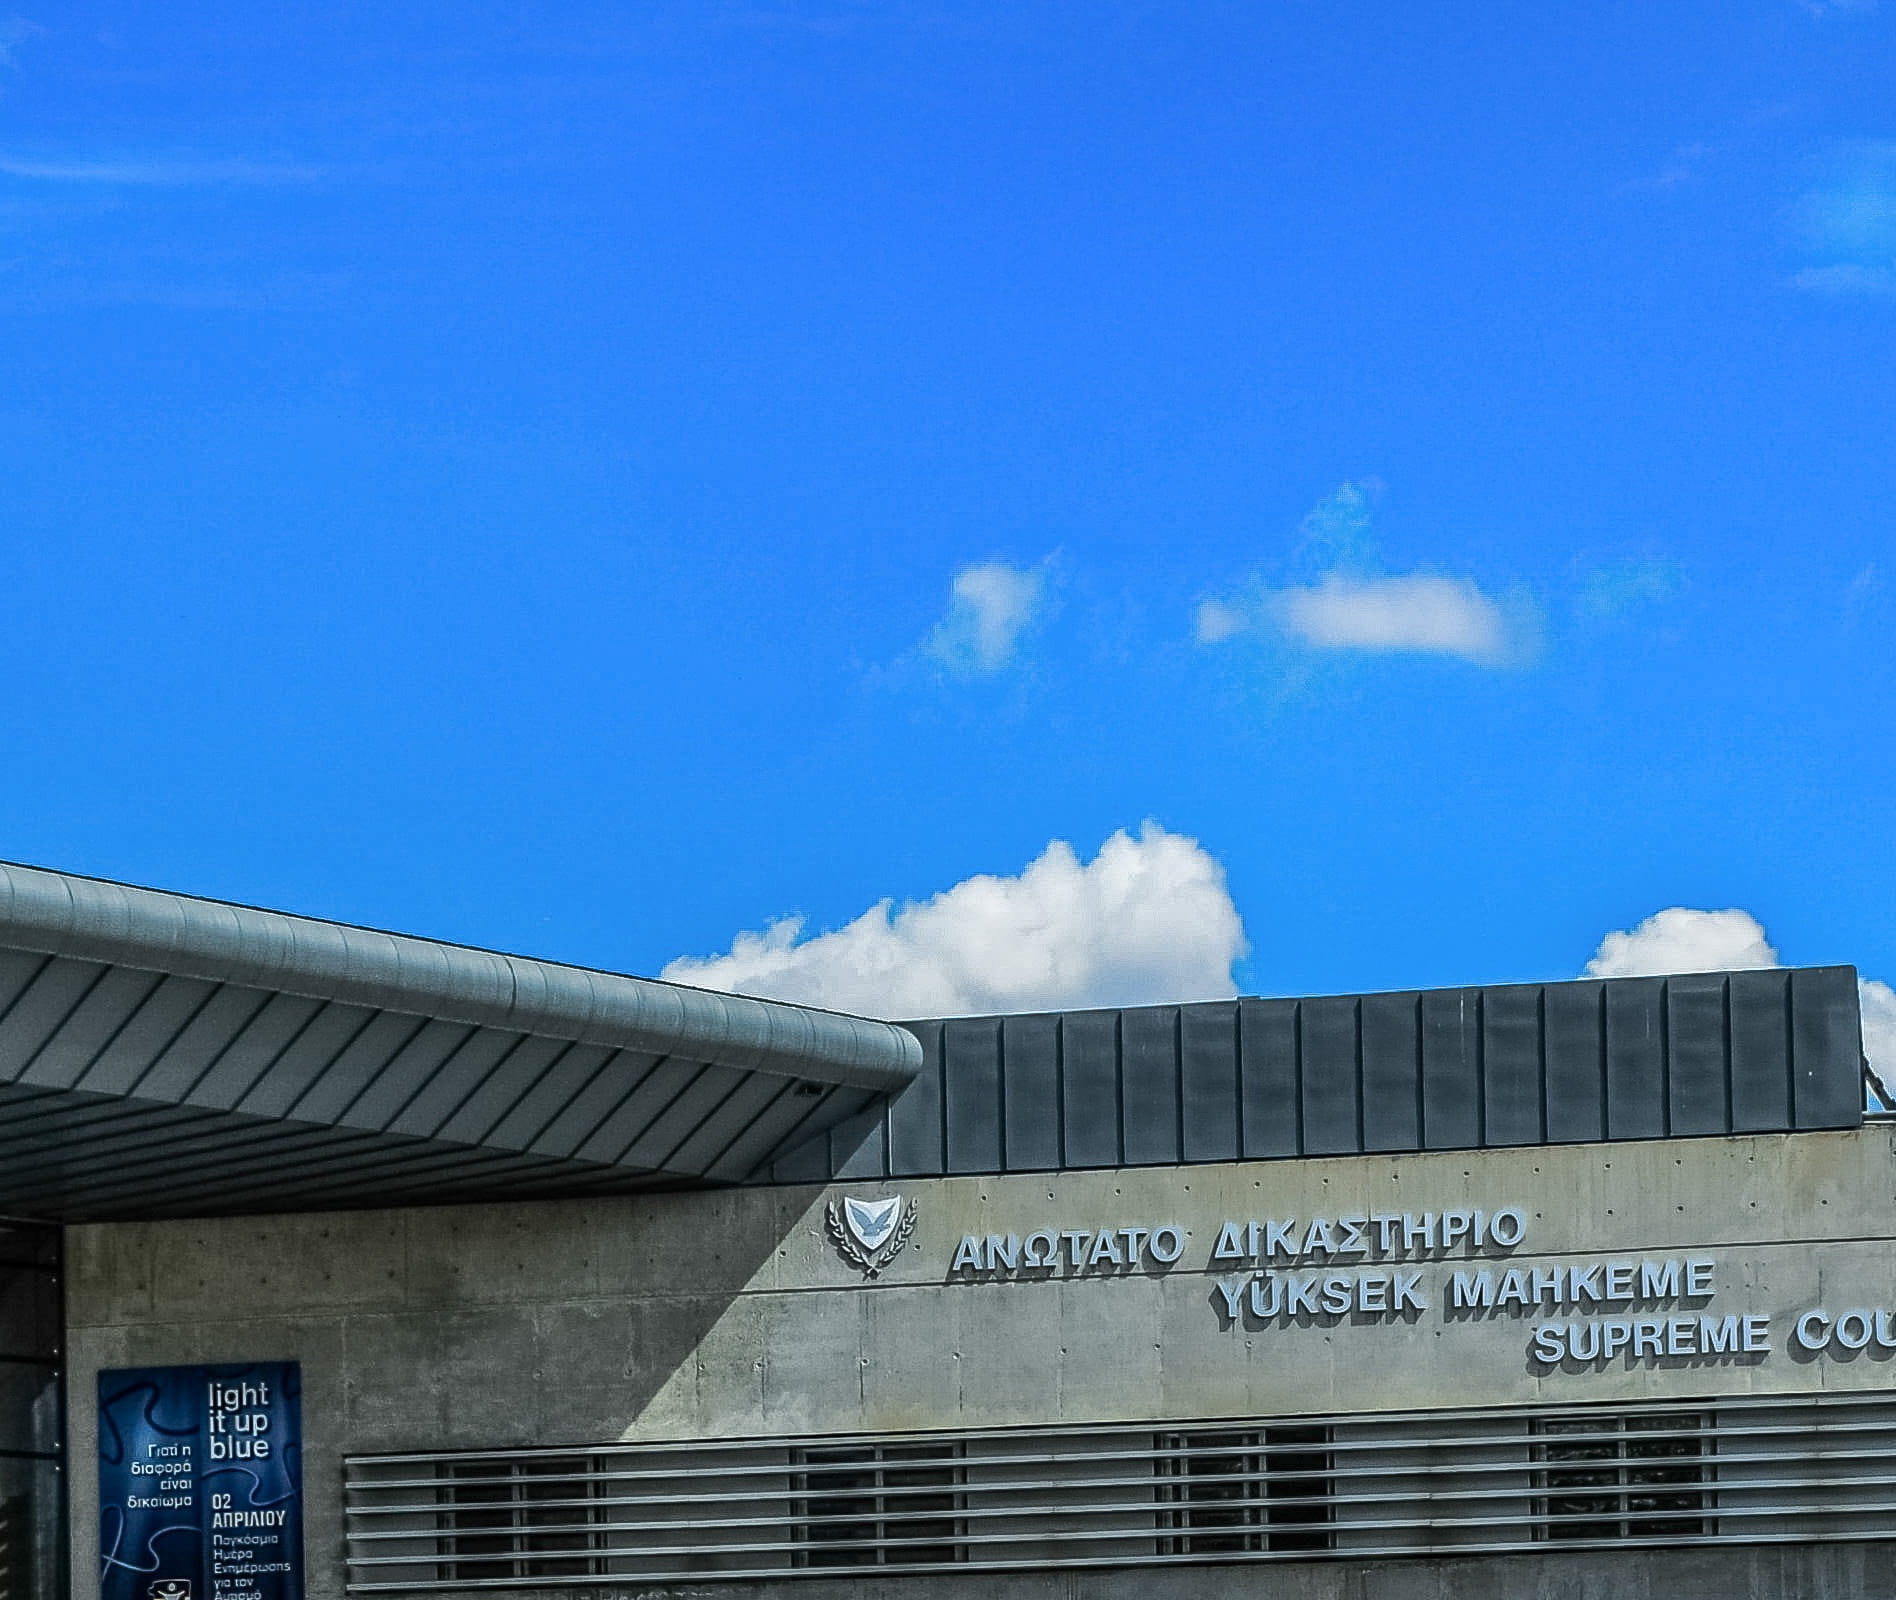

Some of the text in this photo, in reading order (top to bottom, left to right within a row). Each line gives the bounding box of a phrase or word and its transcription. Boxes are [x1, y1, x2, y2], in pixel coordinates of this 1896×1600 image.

[953, 1208, 1527, 1272] ΑΝΩΤΑΤΟ ΔΙΚΑΣΤΗΡΙΟ
[1217, 1258, 1717, 1318] YÜKSEK MAHKEME
[1534, 1313, 1772, 1364] SUPREME
[208, 1382, 269, 1412] light
[209, 1410, 268, 1437] it up
[147, 1443, 178, 1458] Γιατί
[209, 1435, 269, 1459] blue
[130, 1460, 192, 1476] διαφορά
[160, 1477, 192, 1490] είναι
[127, 1495, 192, 1510] δικαίωμα
[212, 1493, 231, 1509] 02
[212, 1511, 286, 1529] ΑΠΡΙΛΙΟΥ
[213, 1534, 278, 1547] Παγκόσμια
[214, 1549, 253, 1561] Ημέρα
[214, 1577, 254, 1590] για τον
